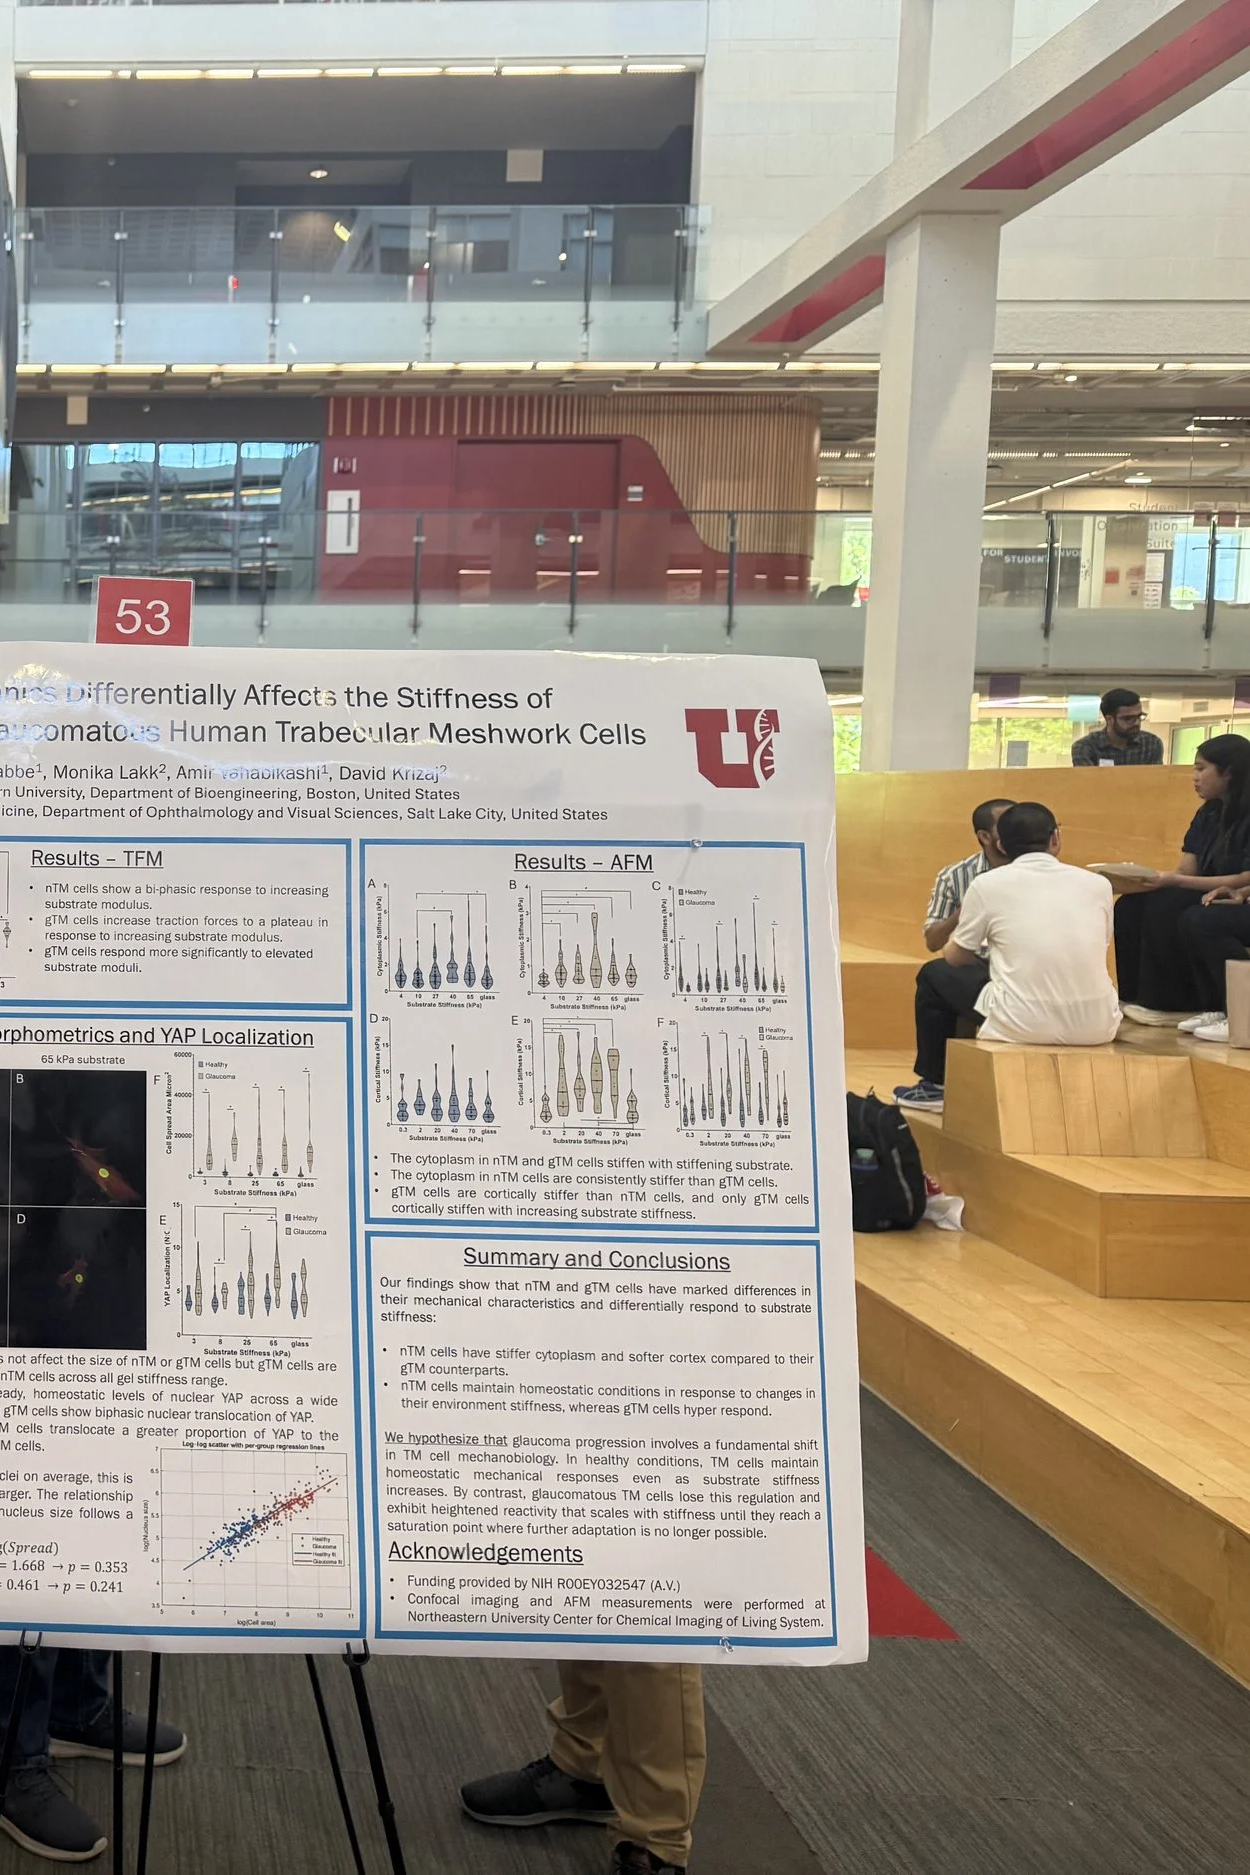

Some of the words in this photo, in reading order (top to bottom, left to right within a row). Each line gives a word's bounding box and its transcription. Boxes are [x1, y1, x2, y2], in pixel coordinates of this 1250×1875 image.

[1054, 549, 1083, 557] INVO
[115, 598, 171, 635] 53
[66, 681, 237, 711] Differentially
[243, 683, 337, 707] Affects
[343, 685, 389, 708] the
[396, 686, 519, 710] Stiffness
[526, 687, 554, 709] of
[170, 719, 267, 743] Human
[275, 720, 421, 744] Trabecular
[429, 722, 572, 745] Meshwork
[579, 722, 647, 746] Cells
[53, 764, 114, 780] Monika
[175, 764, 215, 780] Amir
[339, 765, 386, 781] David
[15, 785, 86, 801] University,
[90, 786, 174, 802] Department
[177, 786, 191, 799] of
[194, 786, 302, 802] Bioengineering,
[306, 787, 360, 802] Boston,
[364, 787, 411, 800] United
[414, 787, 460, 801] States
[42, 804, 126, 820] Department
[128, 805, 144, 818] of
[145, 805, 254, 821] Ophthalmology
[257, 806, 284, 819] and
[286, 806, 331, 819] Visual
[333, 806, 403, 821] Sciences,
[406, 807, 435, 820] Salt
[438, 807, 472, 820] Lake
[475, 807, 506, 823] City,
[511, 807, 558, 821] United
[562, 807, 608, 821] States
[31, 849, 100, 867] Results
[122, 850, 163, 867] TFM
[515, 853, 587, 871] Results
[610, 853, 653, 871] AFM
[368, 879, 376, 888] A
[509, 880, 517, 890] B
[652, 881, 661, 891] C
[369, 1014, 378, 1024] D
[511, 1016, 518, 1025] E
[658, 1018, 664, 1027] F
[119, 1027, 155, 1044] and
[160, 1027, 197, 1044] YAP
[202, 1027, 314, 1046] Localization
[40, 1054, 54, 1064] 65
[56, 1054, 75, 1064] kPa
[76, 1055, 126, 1065] substrate
[16, 1074, 25, 1084] B
[389, 1152, 412, 1164] The
[415, 1153, 475, 1167] cytoplasm
[478, 1154, 490, 1166] in
[492, 1154, 518, 1166] nTM
[521, 1155, 545, 1167] and
[547, 1155, 573, 1170] gTM
[576, 1156, 604, 1168] cells
[606, 1157, 645, 1169] stiffen
[648, 1158, 673, 1169] with
[676, 1158, 733, 1173] stiffening
[735, 1159, 794, 1171] substrate.
[17, 1214, 26, 1225] D
[463, 1246, 560, 1267] Summary
[564, 1250, 603, 1268] and
[608, 1250, 731, 1271] Conclusions
[388, 1540, 584, 1563] Acknowledgements
[407, 1574, 456, 1590] Funding
[459, 1576, 511, 1590] provided
[514, 1577, 528, 1592] by
[531, 1577, 553, 1589] NIH
[650, 1579, 681, 1594] (A.V.)
[408, 1610, 487, 1623] Northeastern
[491, 1612, 551, 1627] University
[553, 1613, 594, 1625] Center
[596, 1613, 613, 1626] for
[616, 1614, 672, 1626] Chemical
[675, 1615, 723, 1630] Imaging
[726, 1615, 739, 1627] of
[742, 1615, 778, 1631] Living
[779, 1616, 824, 1631] System.
